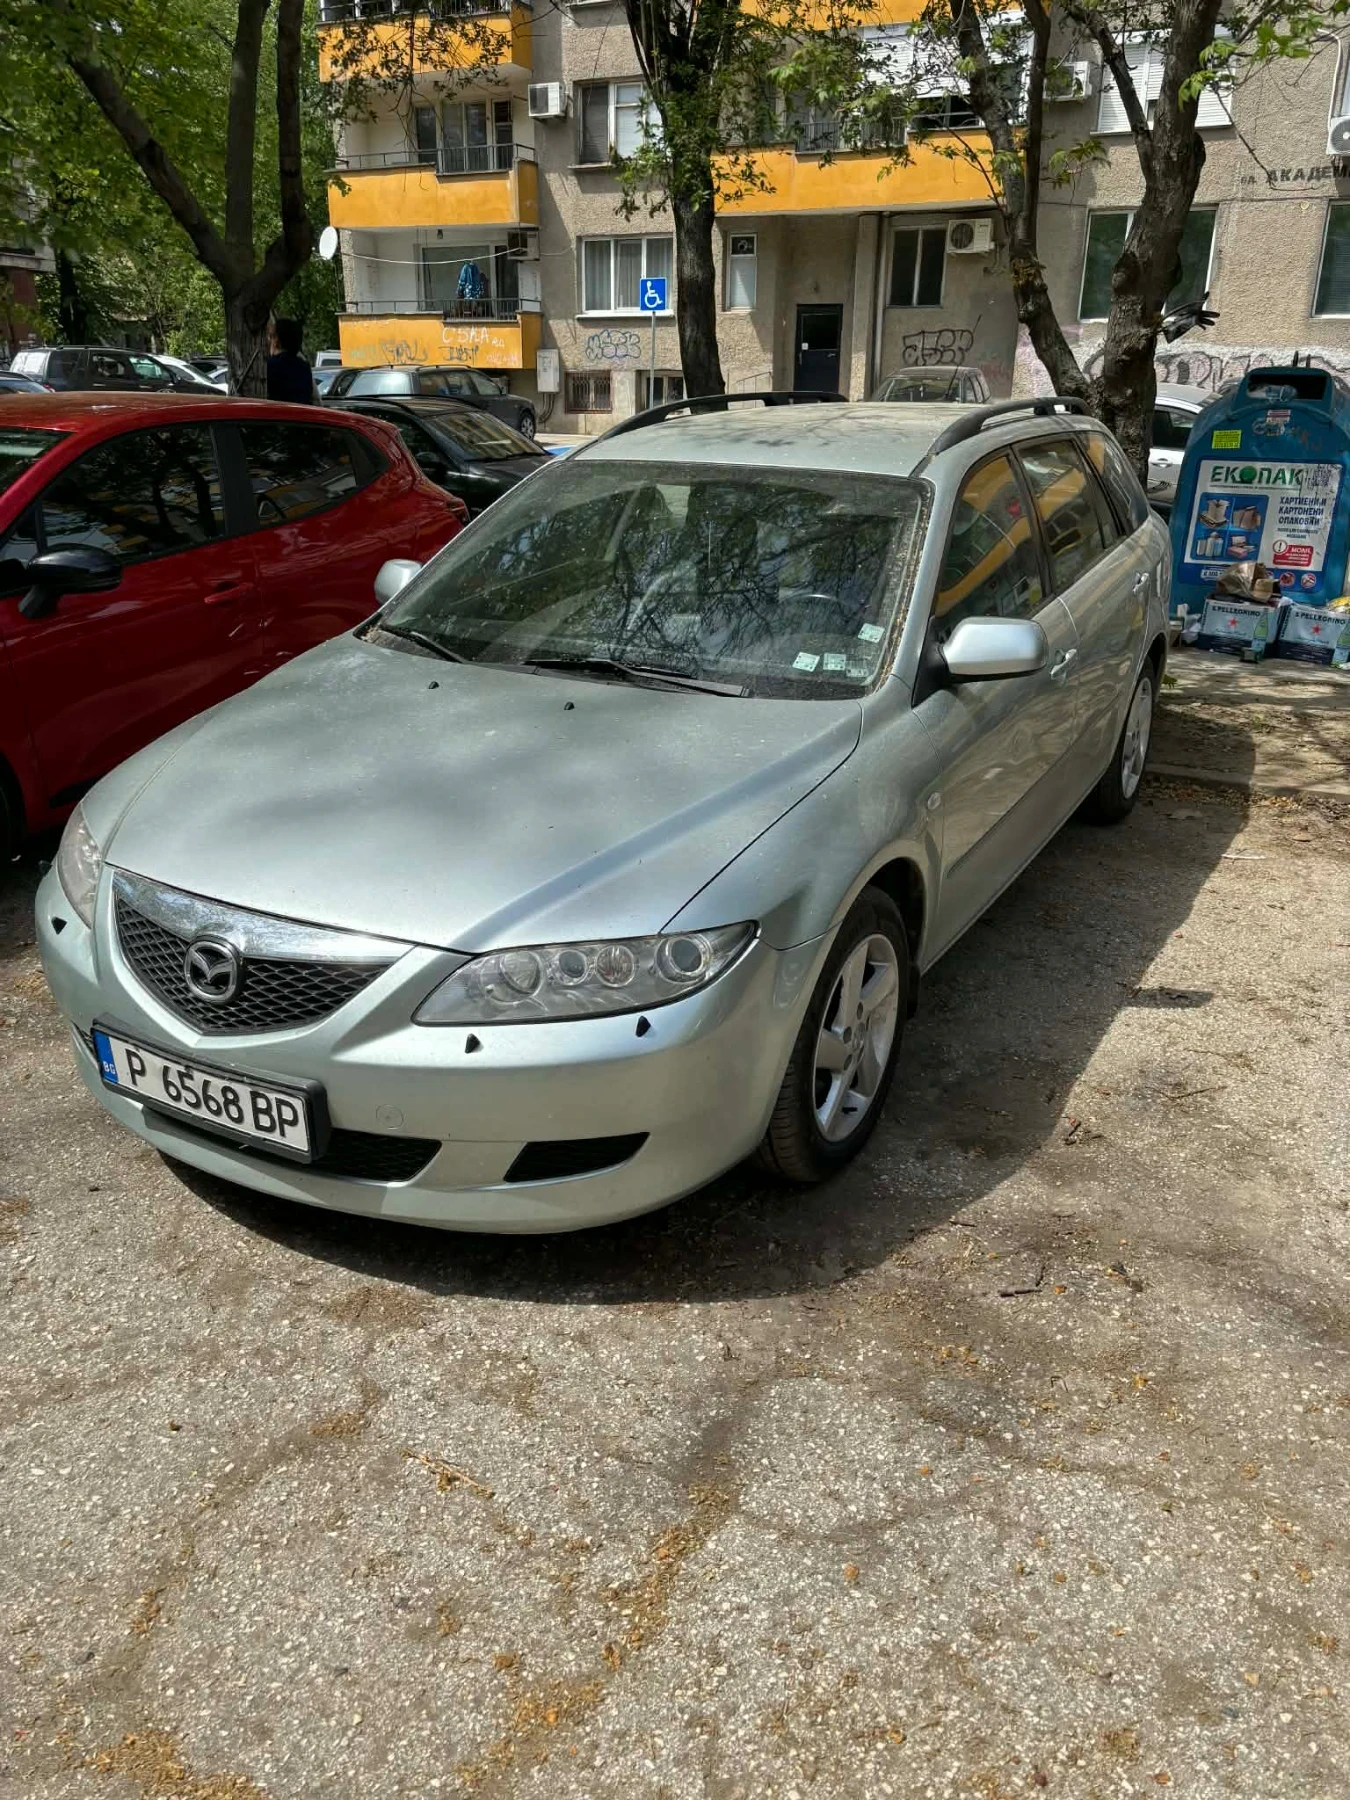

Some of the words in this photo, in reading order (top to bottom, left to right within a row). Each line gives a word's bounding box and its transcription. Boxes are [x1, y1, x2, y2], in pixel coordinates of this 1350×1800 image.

[1266, 164, 1350, 183] АКАДЕМ
[1210, 465, 1303, 485] ЕКОПАК
[1278, 506, 1324, 516] КАРТОНЕНИ
[102, 1060, 116, 1075] BG
[125, 1048, 146, 1086] P
[162, 1065, 244, 1124] 6568
[250, 1090, 299, 1138] BP
